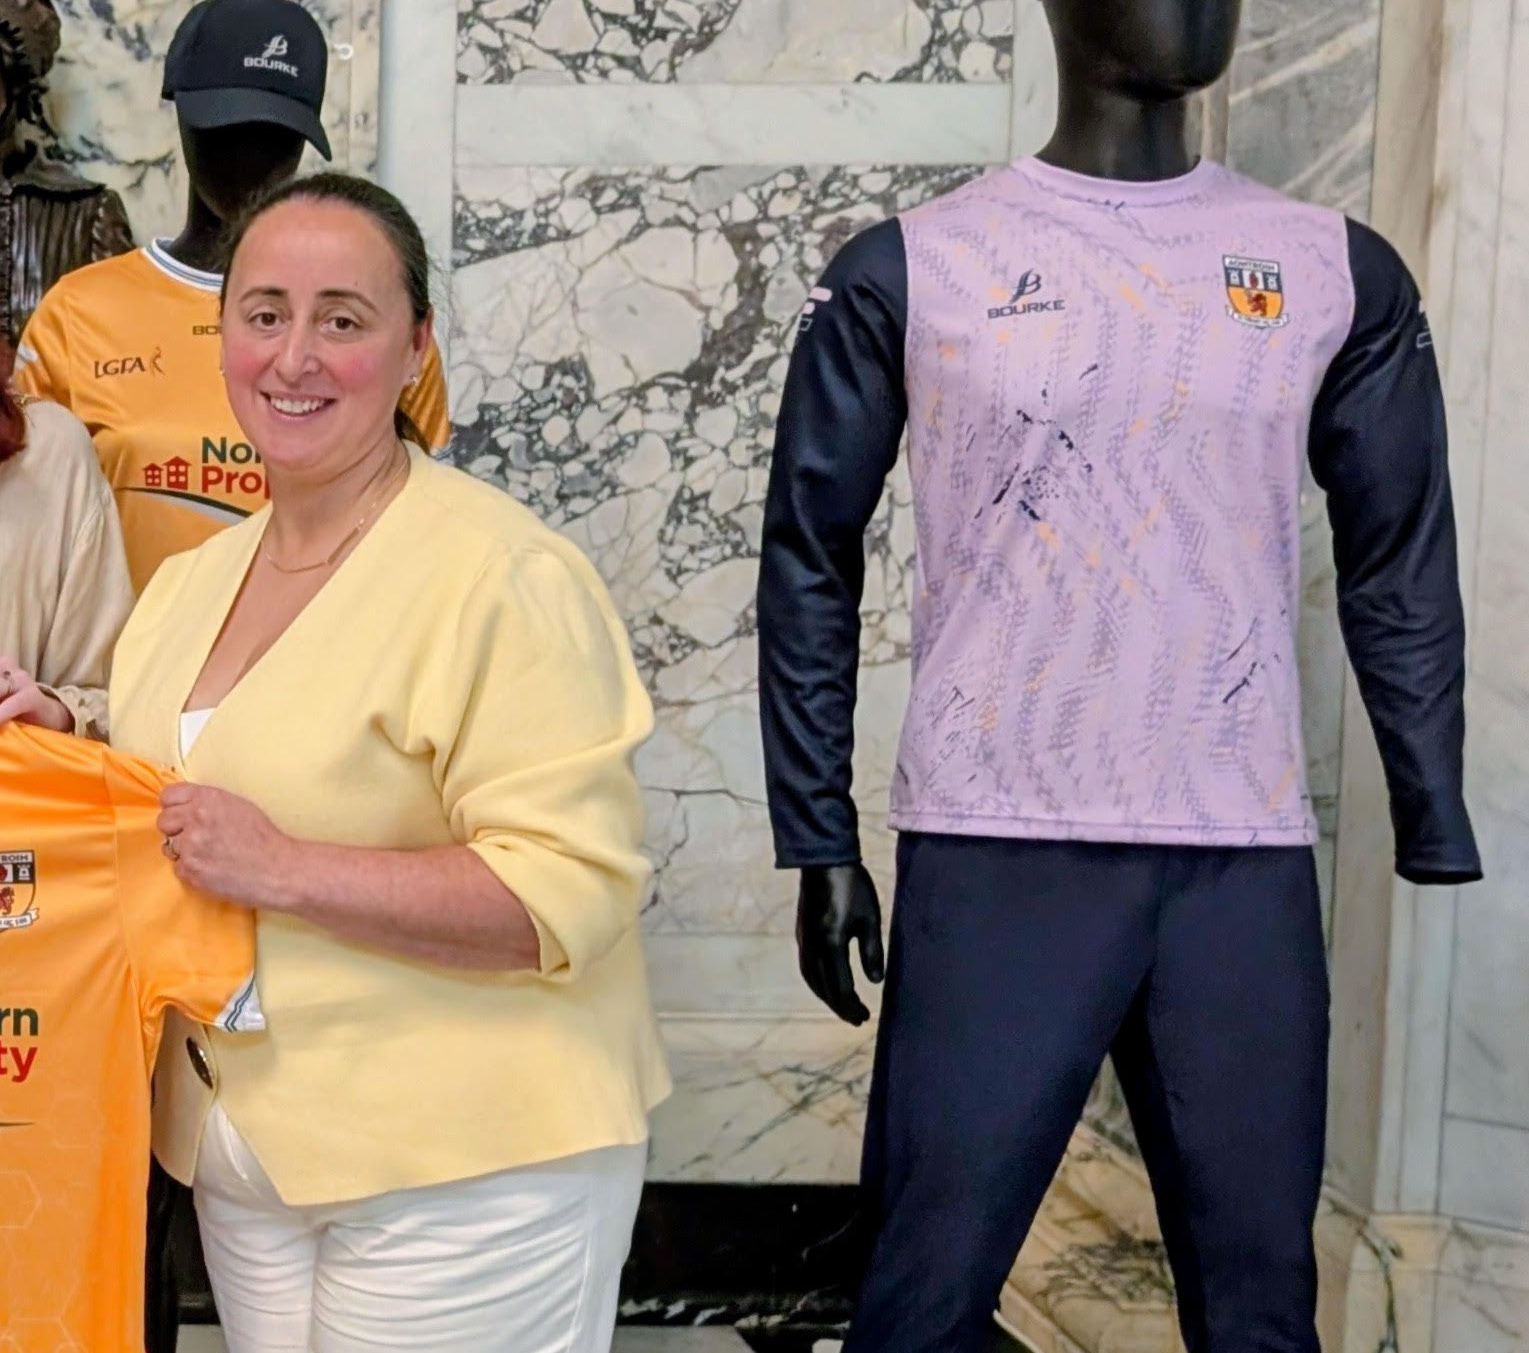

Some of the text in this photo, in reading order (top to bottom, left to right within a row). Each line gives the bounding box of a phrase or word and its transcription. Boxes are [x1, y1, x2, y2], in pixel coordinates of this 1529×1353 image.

[243, 57, 299, 77] BOURKE
[987, 299, 1066, 319] BOURKE
[94, 357, 146, 379] LGFA
